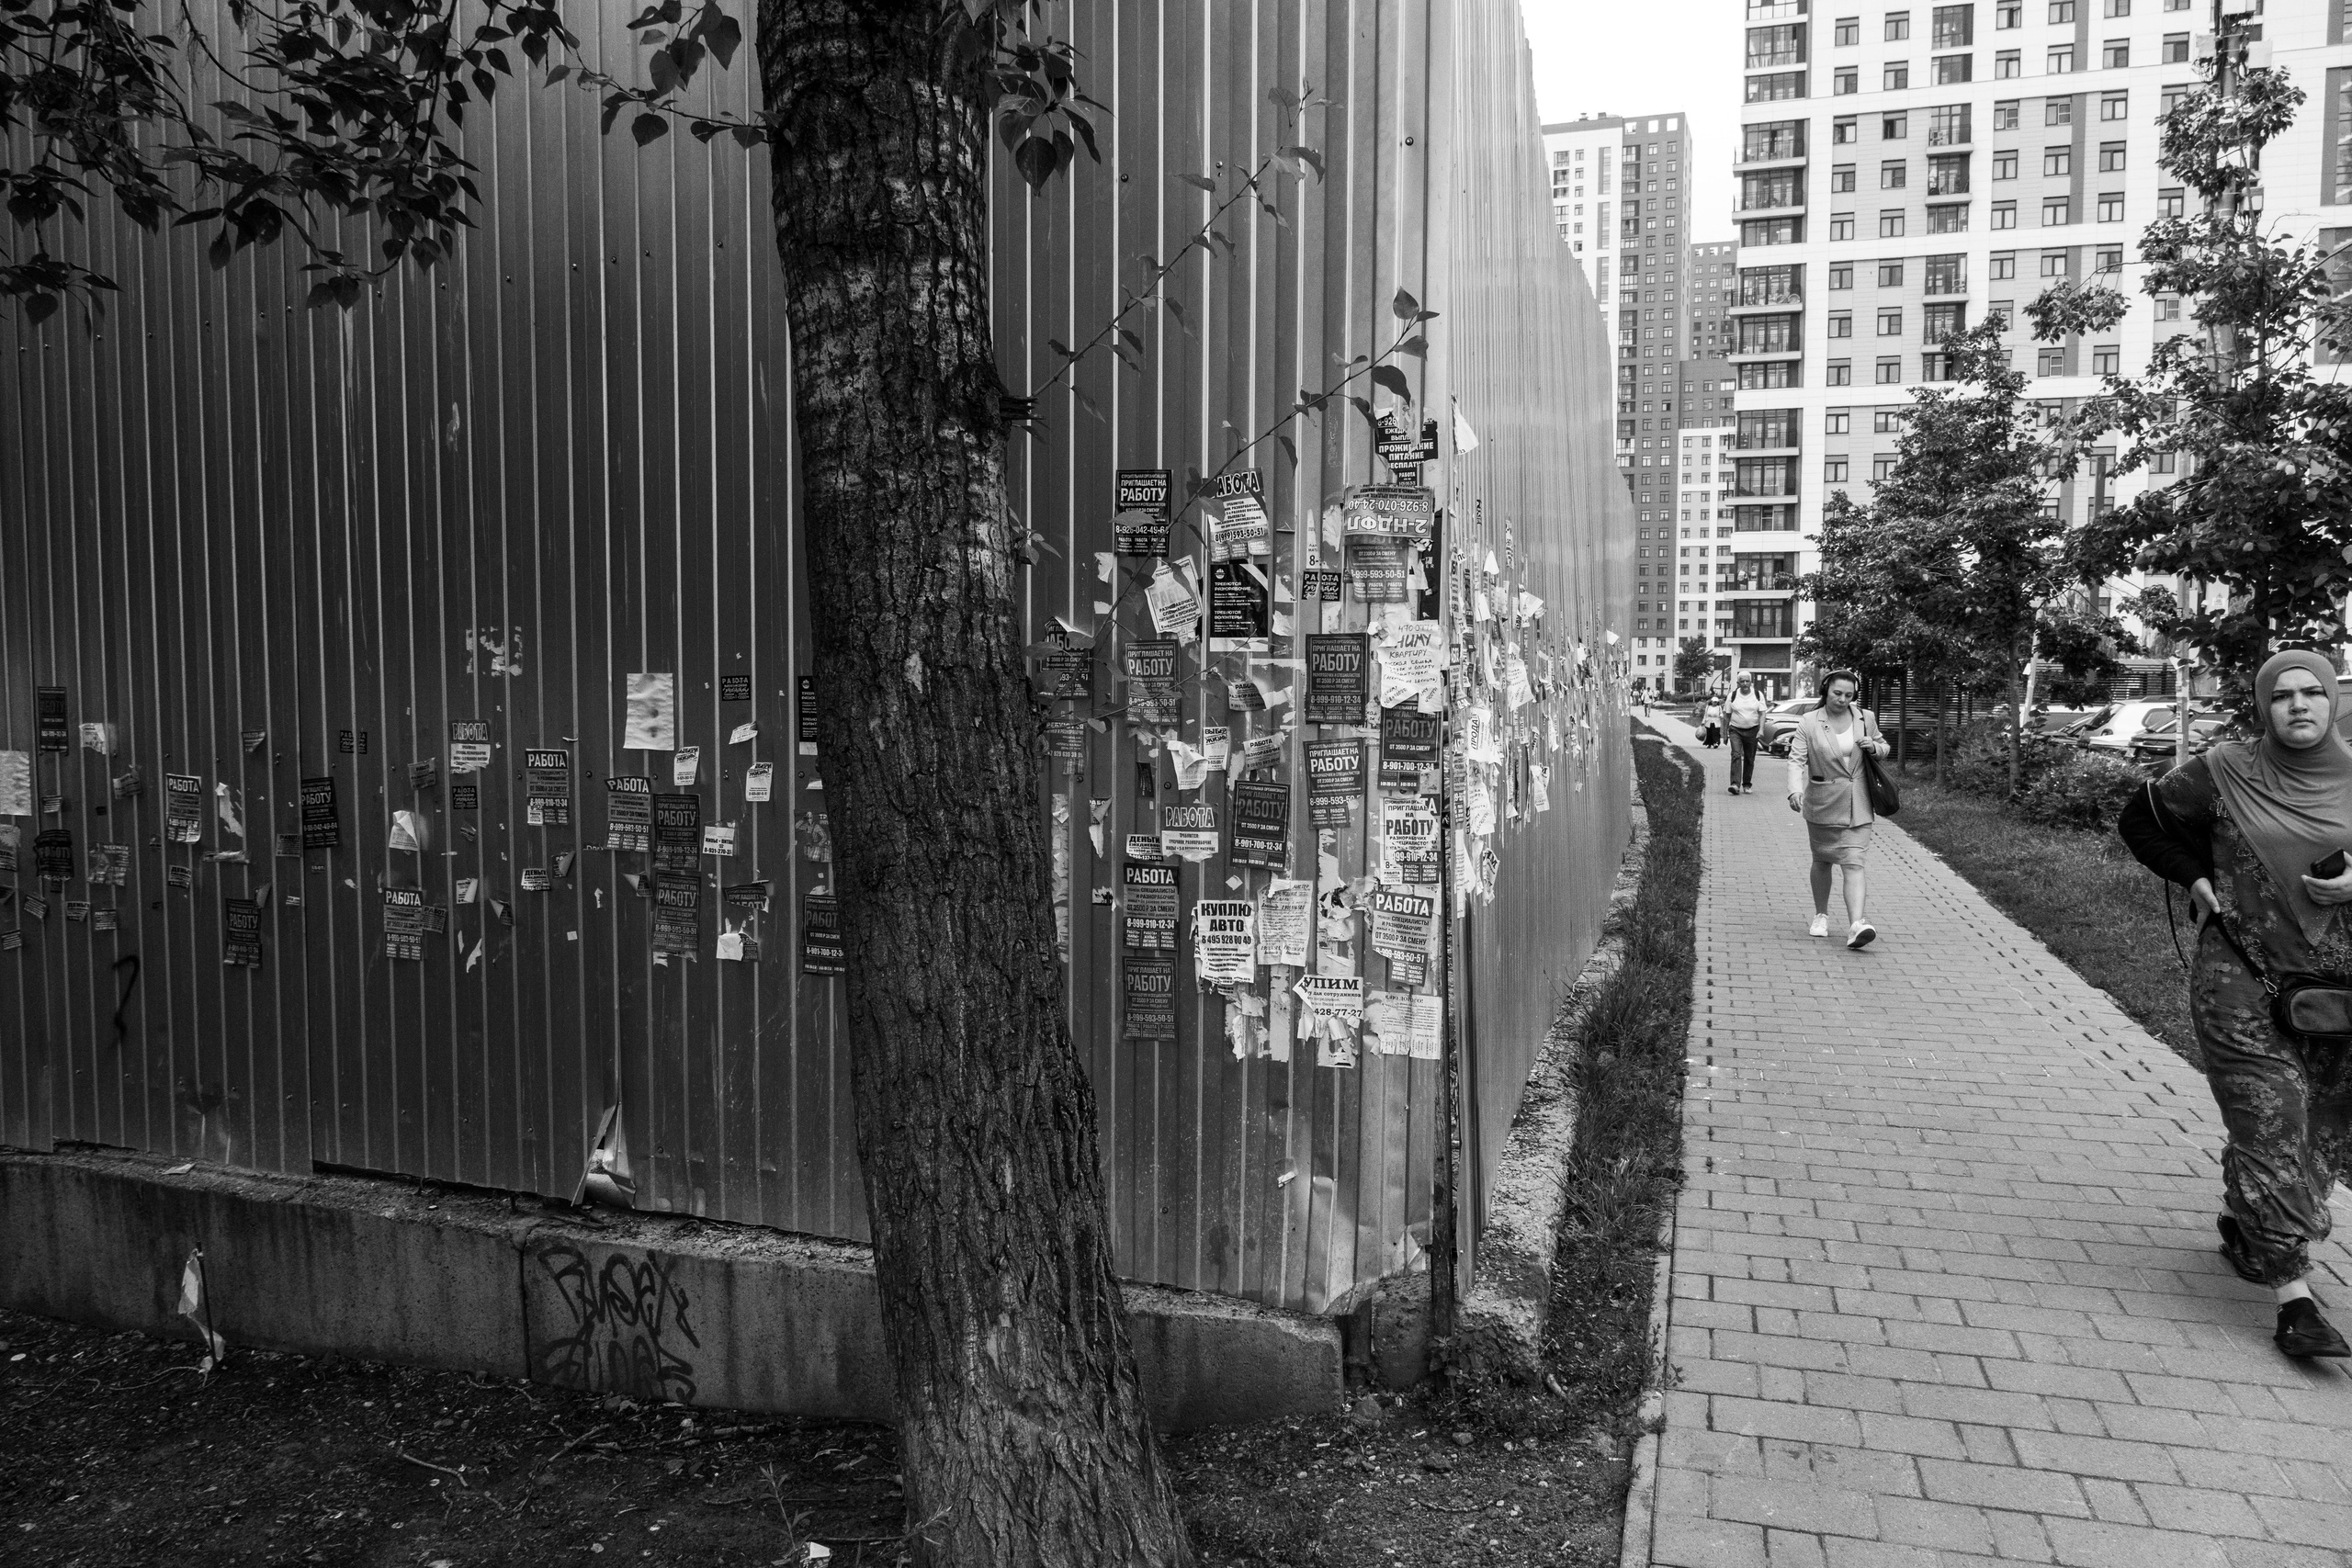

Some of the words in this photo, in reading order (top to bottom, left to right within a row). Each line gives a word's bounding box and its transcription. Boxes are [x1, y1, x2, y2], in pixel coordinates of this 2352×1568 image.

[1388, 451, 1424, 461] ПИТАНИЕ
[1121, 488, 1167, 502] РАБОТУ
[1349, 499, 1429, 513] 8-926-070-24-40
[1347, 514, 1428, 533] 2-НДФЛ
[1389, 649, 1427, 659] КВАРТИРУ
[1129, 659, 1173, 675] РАБОТУ
[1313, 653, 1360, 671] РАБОТУ
[1310, 695, 1362, 704] 8-999-910-12-34
[452, 722, 488, 740] РАБОТА
[1385, 719, 1435, 738] РАБОТУ
[1250, 739, 1272, 748] РАБОТА
[527, 753, 566, 767] РАБОТА
[1309, 749, 1349, 757] ПРИГЛАШАЕТ
[1310, 756, 1359, 772] РАБОТУ
[168, 778, 200, 793] РАБОТА
[606, 778, 650, 793] РАБОТА
[1238, 791, 1276, 799] ПРИГЛАШАЕТ
[1238, 798, 1284, 818] РАБОТУ
[658, 810, 695, 826] РАБОТУ
[1165, 807, 1215, 828] РАБОТА
[1386, 819, 1433, 835] РАБОТУ
[1235, 839, 1283, 851] 8-901-700-12-34
[1126, 867, 1174, 884] РАБОТА
[386, 891, 421, 906] РАБОТА
[658, 889, 696, 907] РАБОТУ
[1375, 893, 1429, 916] РАБОТА
[1201, 903, 1252, 917] КУПЛЮ
[807, 911, 838, 928] РАБОТ
[1126, 919, 1174, 929] 8-999-910-12-34
[1209, 919, 1244, 931] АВТО
[1385, 922, 1422, 931] РАЗНОРАБОЧИЕ
[1392, 916, 1429, 926] СПЕЦИАЛИСТЫ
[1202, 935, 1205, 944] 8
[1207, 935, 1220, 944] 495
[1222, 935, 1233, 944] 928
[1242, 936, 1251, 944] 40
[1408, 937, 1427, 945] СМЕНУ
[1127, 975, 1171, 992] РАБОТУ
[1314, 1009, 1363, 1017] 428-77-27
